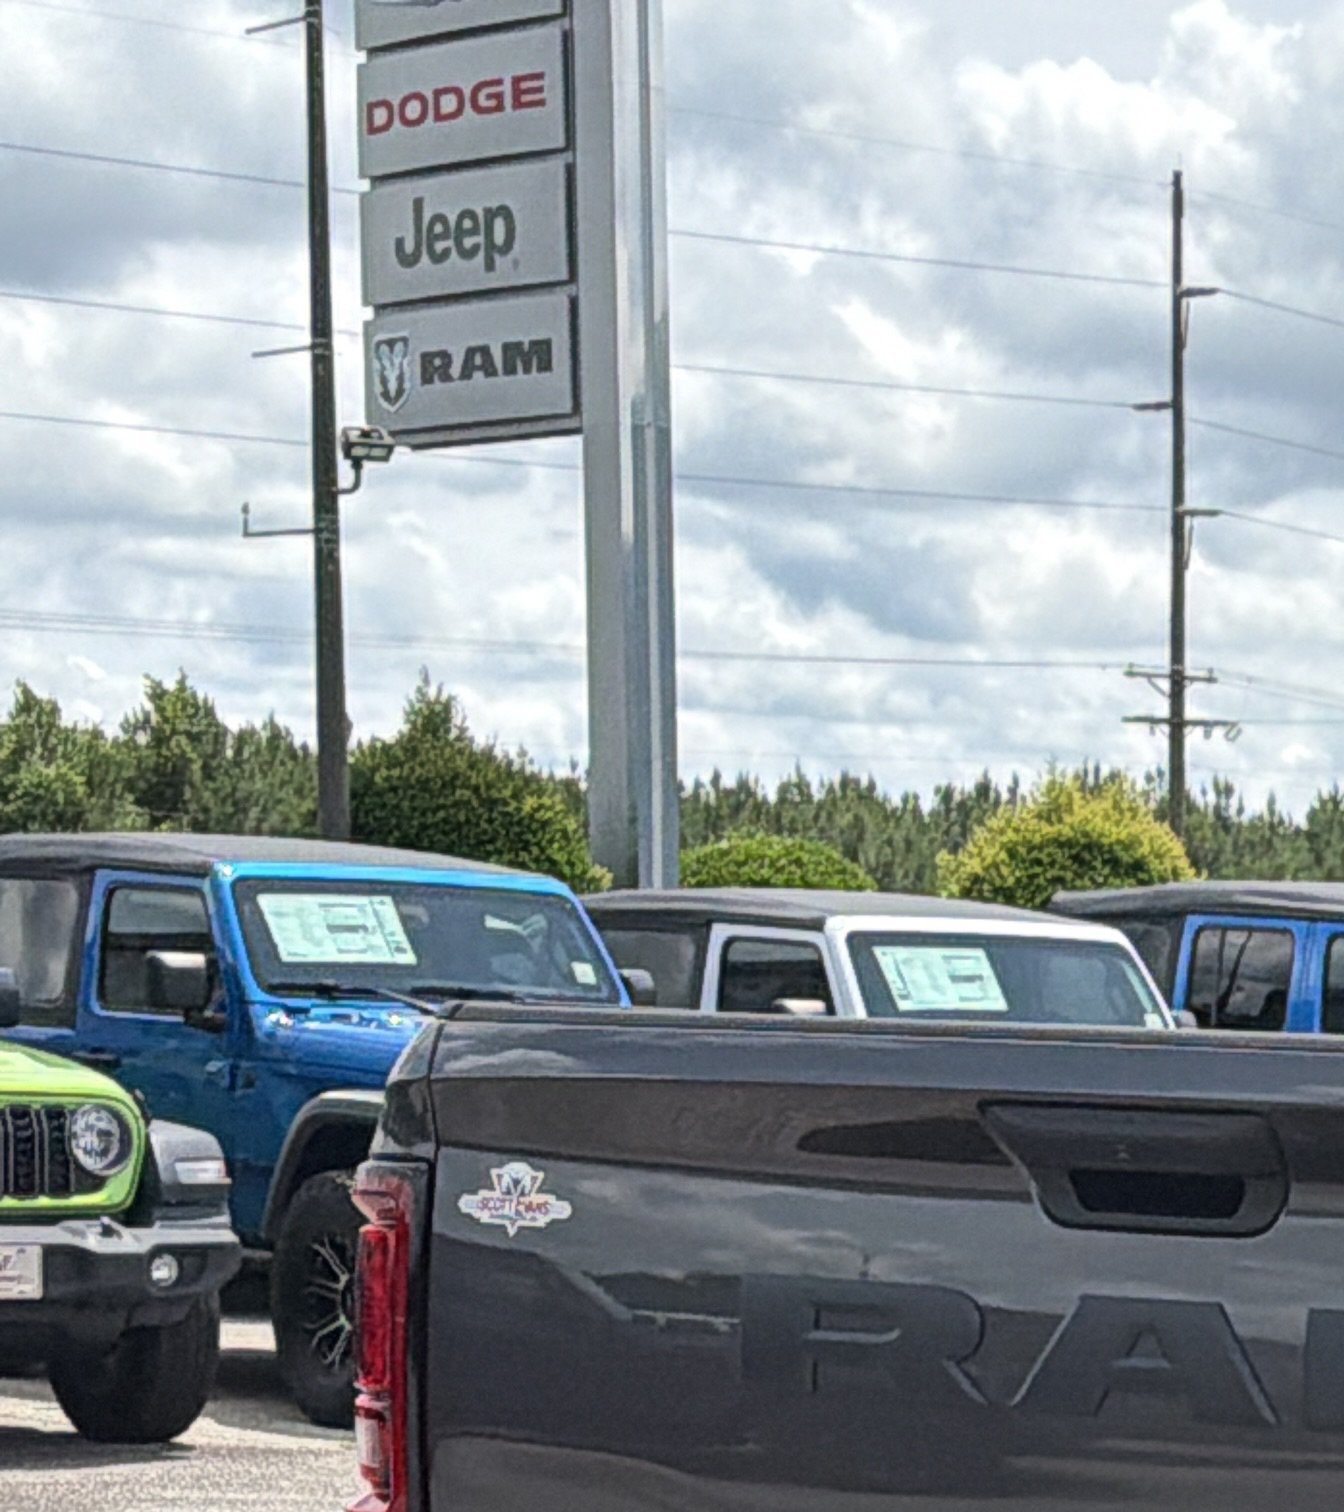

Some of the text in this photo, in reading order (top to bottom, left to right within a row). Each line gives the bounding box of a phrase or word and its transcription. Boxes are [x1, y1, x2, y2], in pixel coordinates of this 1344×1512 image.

[366, 72, 547, 136] DODGE
[395, 197, 516, 273] Jeep
[420, 338, 553, 386] RAM
